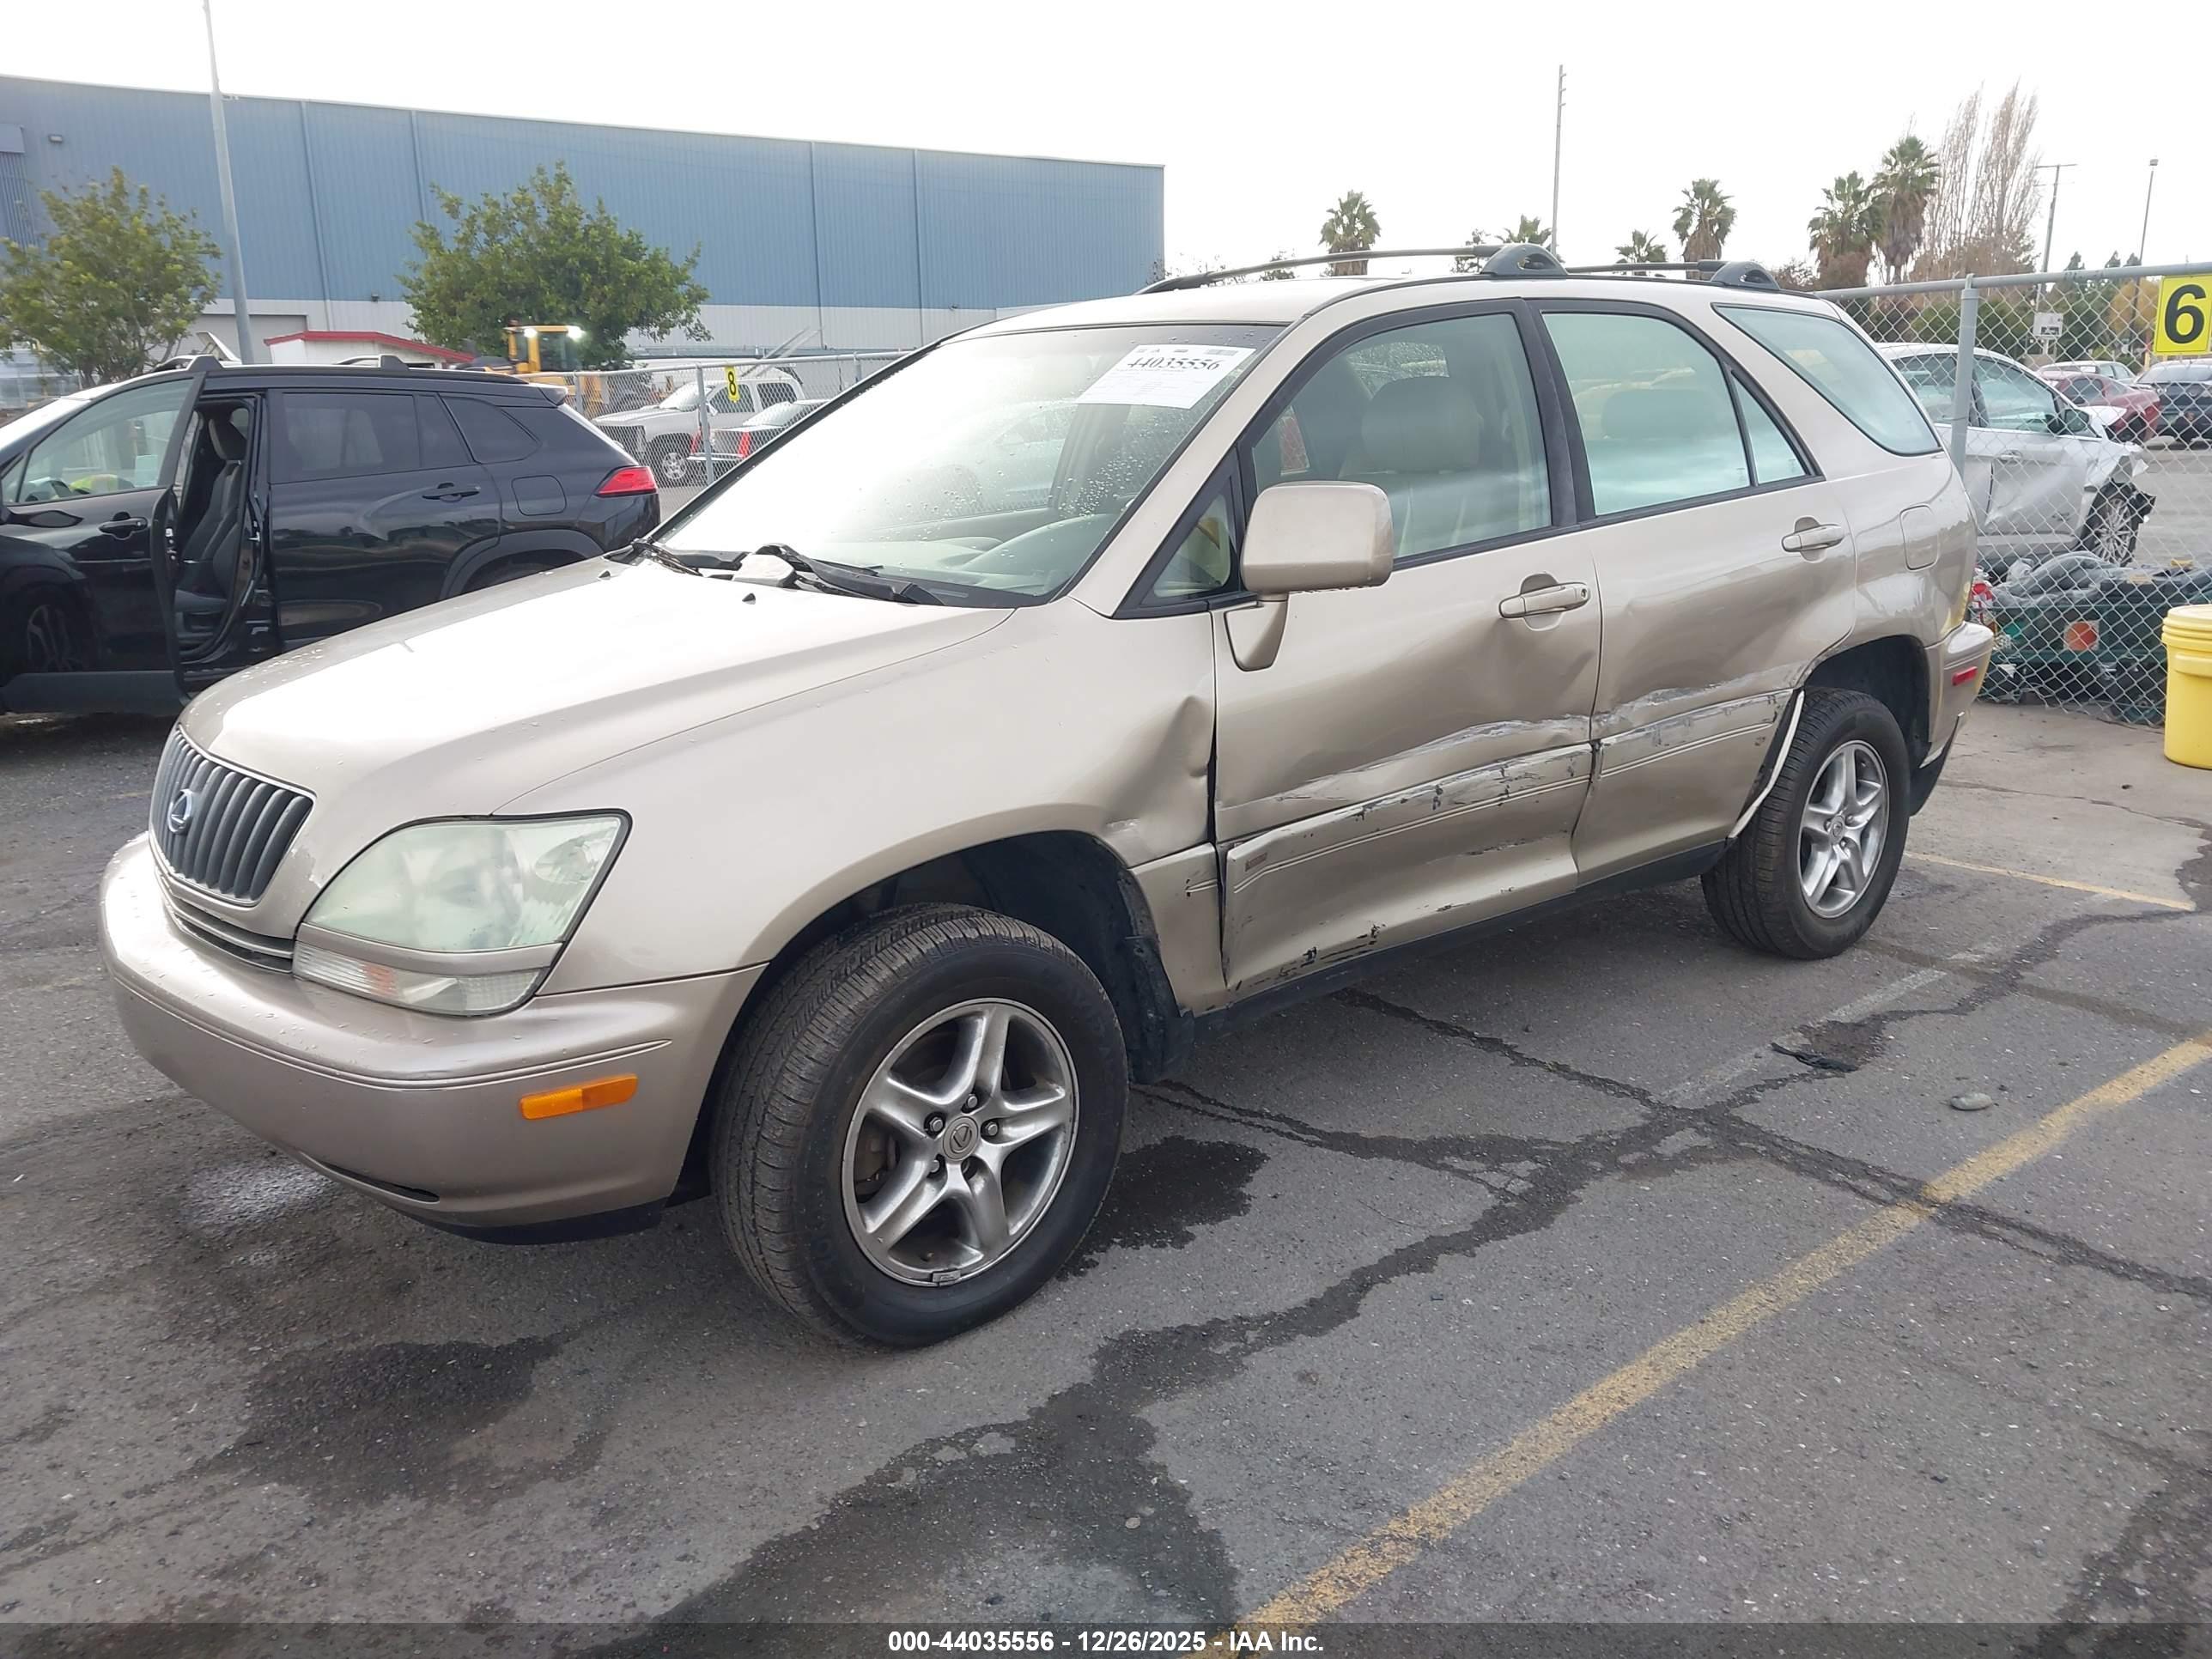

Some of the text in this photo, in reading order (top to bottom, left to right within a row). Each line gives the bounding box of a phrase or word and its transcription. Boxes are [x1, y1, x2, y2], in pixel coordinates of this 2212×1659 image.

[2165, 284, 2206, 343] 6
[1127, 357, 1223, 370] 44035556
[727, 371, 737, 396] 8
